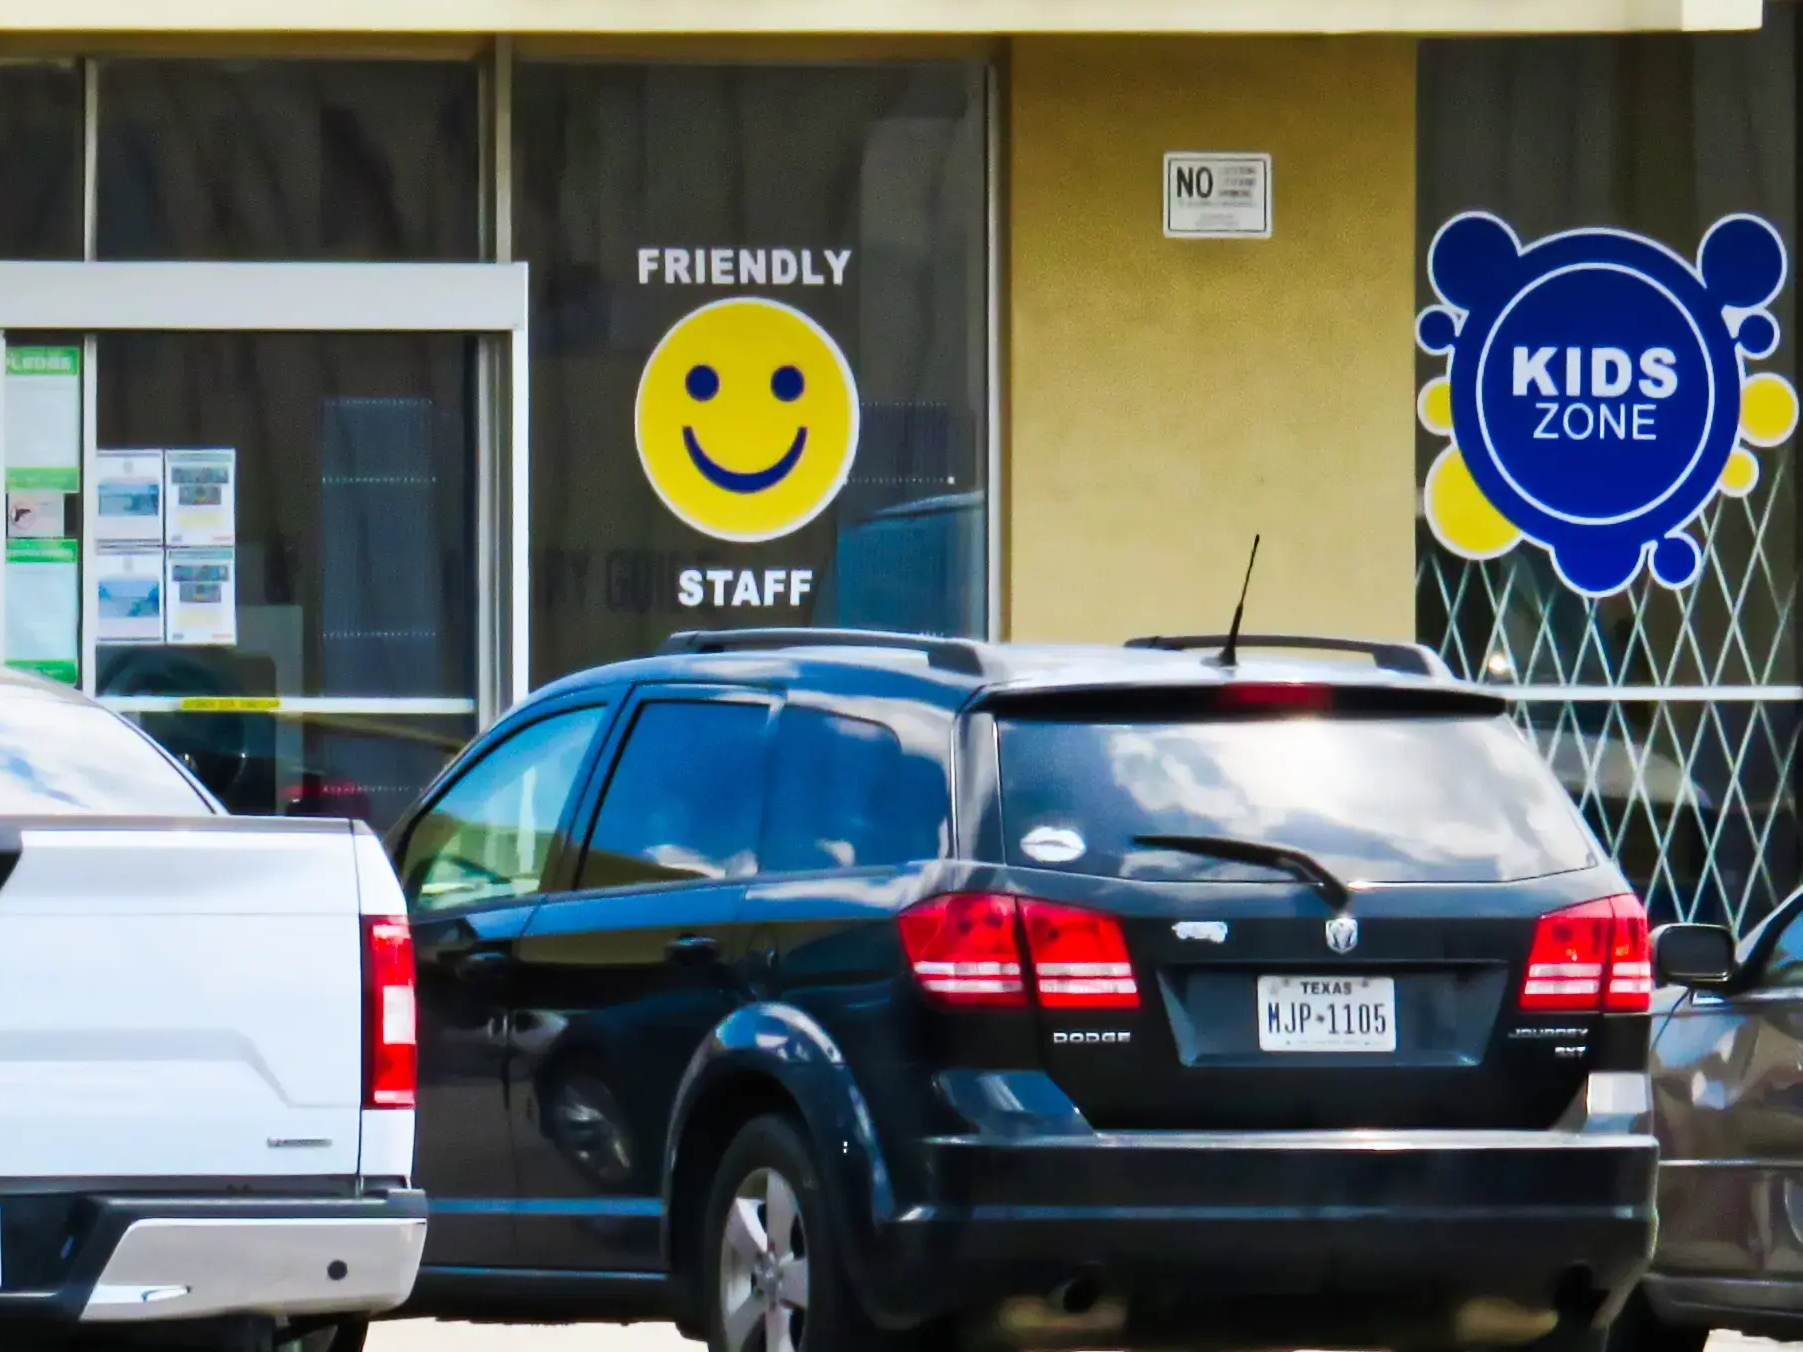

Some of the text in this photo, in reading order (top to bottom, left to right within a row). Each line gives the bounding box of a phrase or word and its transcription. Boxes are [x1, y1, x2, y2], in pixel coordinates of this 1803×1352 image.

[1176, 166, 1214, 199] NO
[637, 248, 852, 286] FRIENDLY
[1511, 346, 1679, 399] KIDS
[1532, 402, 1658, 441] ZONE
[677, 569, 814, 608] STAFF
[1300, 981, 1353, 995] TEXAS
[1053, 1031, 1131, 1044] DODGE
